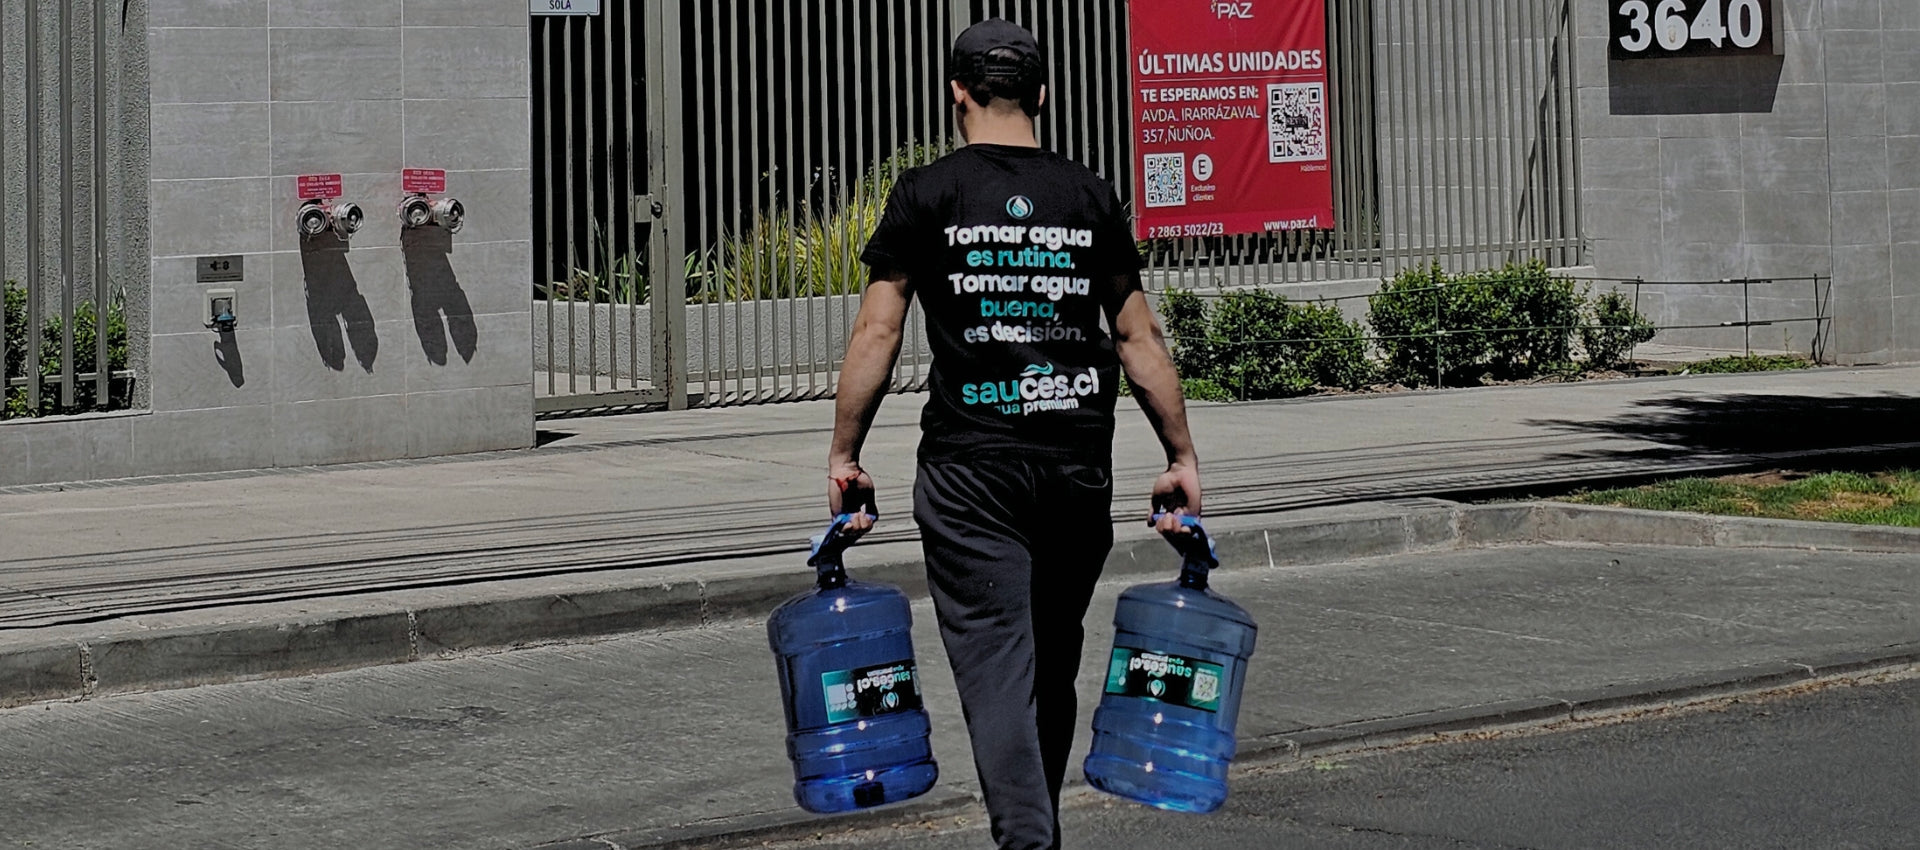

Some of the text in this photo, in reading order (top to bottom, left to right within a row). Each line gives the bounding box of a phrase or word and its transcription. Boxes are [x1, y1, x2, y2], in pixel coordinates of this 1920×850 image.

[550, 0, 572, 10] SOLA
[1216, 2, 1254, 19] PAZ
[1618, 0, 1763, 52] 3640
[1138, 49, 1322, 75] ÚLTIMAS UNIDADES
[1140, 86, 1259, 103] TE ESPERAMOS EN:
[1142, 103, 1260, 123] AVDA. IRARRÁZAVAL
[1142, 125, 1216, 144] 357,ÑUÑOA.
[1198, 160, 1207, 175] E
[1149, 222, 1224, 238] 2 2863 5022/23
[1264, 216, 1317, 232] www.paz.cl
[944, 225, 1092, 250] Tomar agua
[966, 245, 1076, 270] es rutina.
[948, 272, 1090, 301] Tomar agua
[980, 297, 1060, 322] buena,
[964, 320, 1087, 344] es decisión.
[962, 366, 1100, 404] sauces.cl
[994, 396, 1080, 416] ua premium
